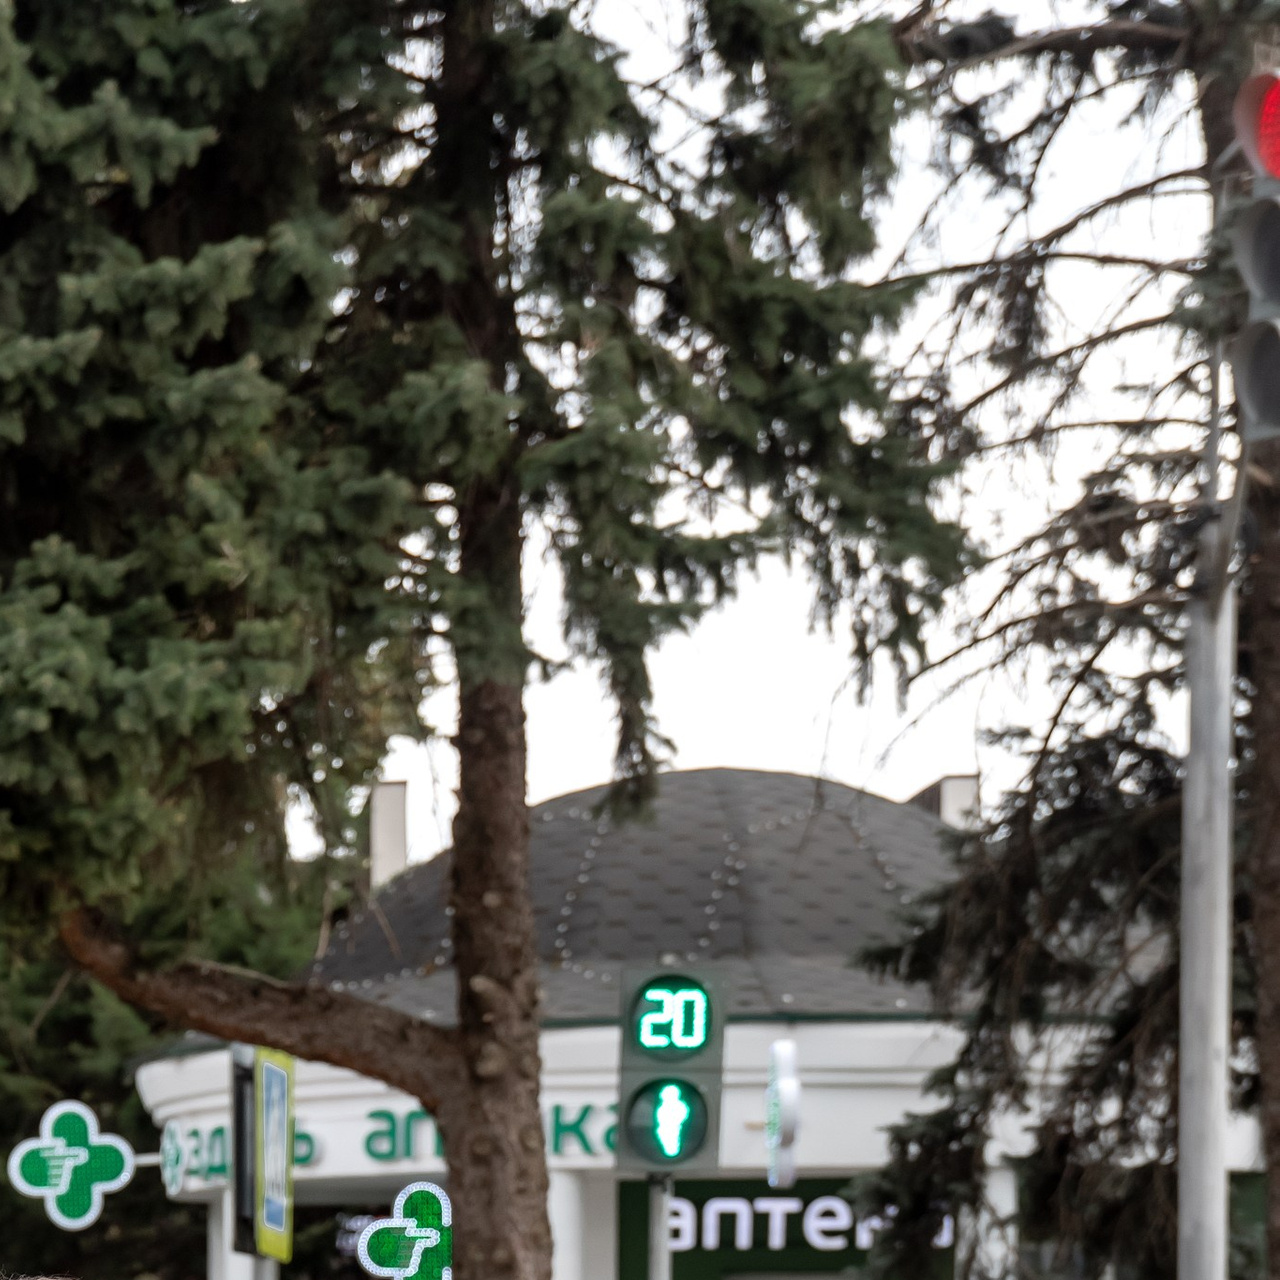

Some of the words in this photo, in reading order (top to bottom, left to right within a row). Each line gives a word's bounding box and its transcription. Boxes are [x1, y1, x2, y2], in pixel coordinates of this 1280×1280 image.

[640, 988, 708, 1048] 20
[185, 1118, 315, 1177] здь
[365, 1104, 619, 1161] апк
[669, 1196, 955, 1251] апте
